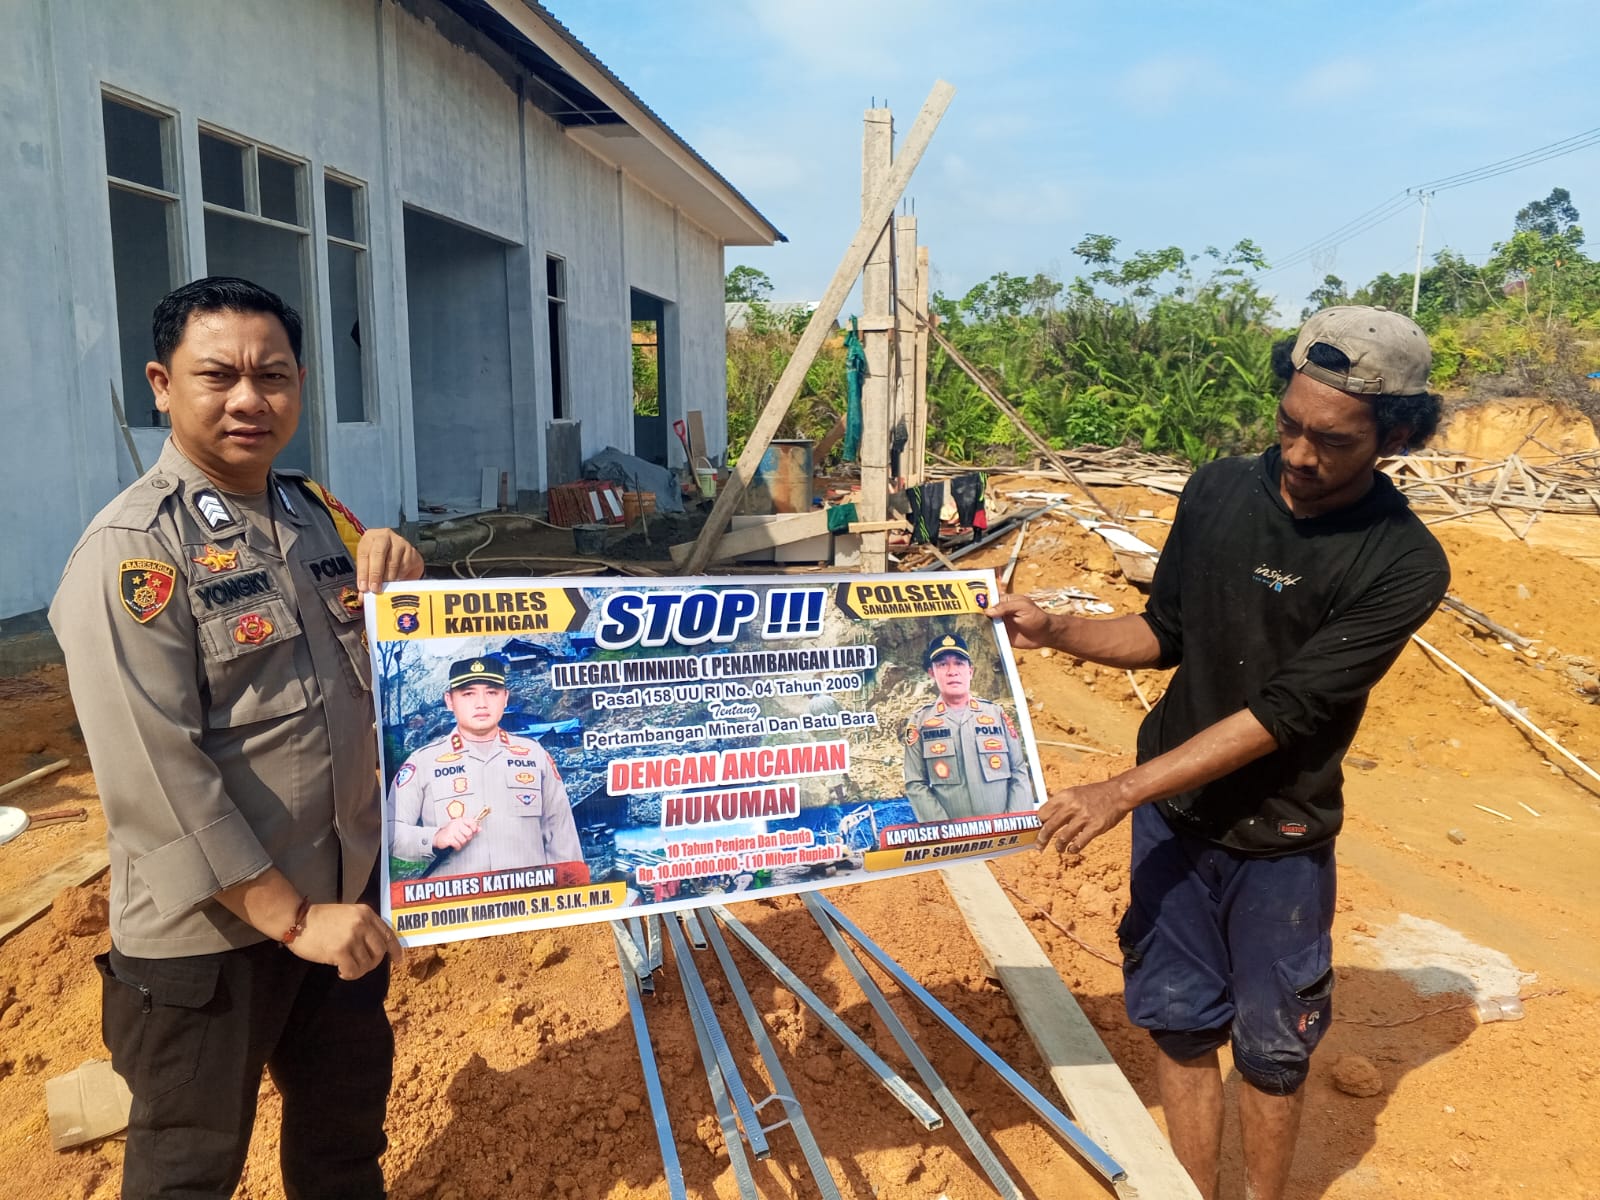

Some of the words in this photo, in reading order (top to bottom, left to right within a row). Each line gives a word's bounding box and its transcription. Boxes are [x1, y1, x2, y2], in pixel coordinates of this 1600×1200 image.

[444, 591, 548, 615] POLRES
[856, 584, 958, 604] POLSEK
[861, 605, 912, 615] SANAMAN
[914, 601, 962, 613] MANTIKEI
[445, 613, 549, 634] KATINGAN
[599, 592, 756, 643] STOP
[554, 665, 623, 688] ILLEGAL
[623, 658, 698, 682] MINNING
[832, 649, 867, 668] LIAR
[595, 690, 640, 708] Pasal
[644, 689, 672, 704] 158
[676, 687, 699, 701] UU
[706, 686, 721, 699] RI
[726, 683, 751, 699] No.
[755, 681, 773, 696] 04
[776, 678, 822, 695] Tahun
[826, 676, 860, 691] 2009
[710, 703, 760, 720] Tentang
[586, 727, 704, 749] Pertambangan
[708, 719, 764, 736] Mineral
[769, 716, 800, 732] Dan
[803, 713, 838, 729] Batu
[841, 710, 876, 726] Bara
[434, 765, 466, 778] DODIK
[507, 759, 537, 768] POLRI
[611, 755, 717, 792] DENGAN
[721, 743, 846, 781] ANCAMAN
[664, 786, 797, 828] HUKUMAN
[667, 843, 679, 858] 10
[680, 840, 714, 857] Tahun
[715, 836, 756, 856] Penjara
[757, 833, 778, 849] Dan
[779, 829, 812, 846] Denda
[885, 824, 940, 846] KAPOLSEK
[941, 819, 993, 839] SANAMAN
[903, 849, 930, 863] AKP
[997, 835, 1020, 847] S.H.
[638, 866, 656, 883] Rp.
[752, 853, 764, 869] 10
[765, 851, 798, 867] Milyar
[799, 848, 834, 864] Rupiah
[404, 878, 480, 903] KAPOLRES
[482, 868, 555, 894] KATINGAN
[396, 915, 430, 932] AKBP
[431, 908, 470, 928] DODIK
[471, 901, 530, 922] HARTONO,
[531, 898, 555, 914] S.H.,
[556, 894, 588, 912] S.I.K.,
[589, 889, 614, 906] M.H.
